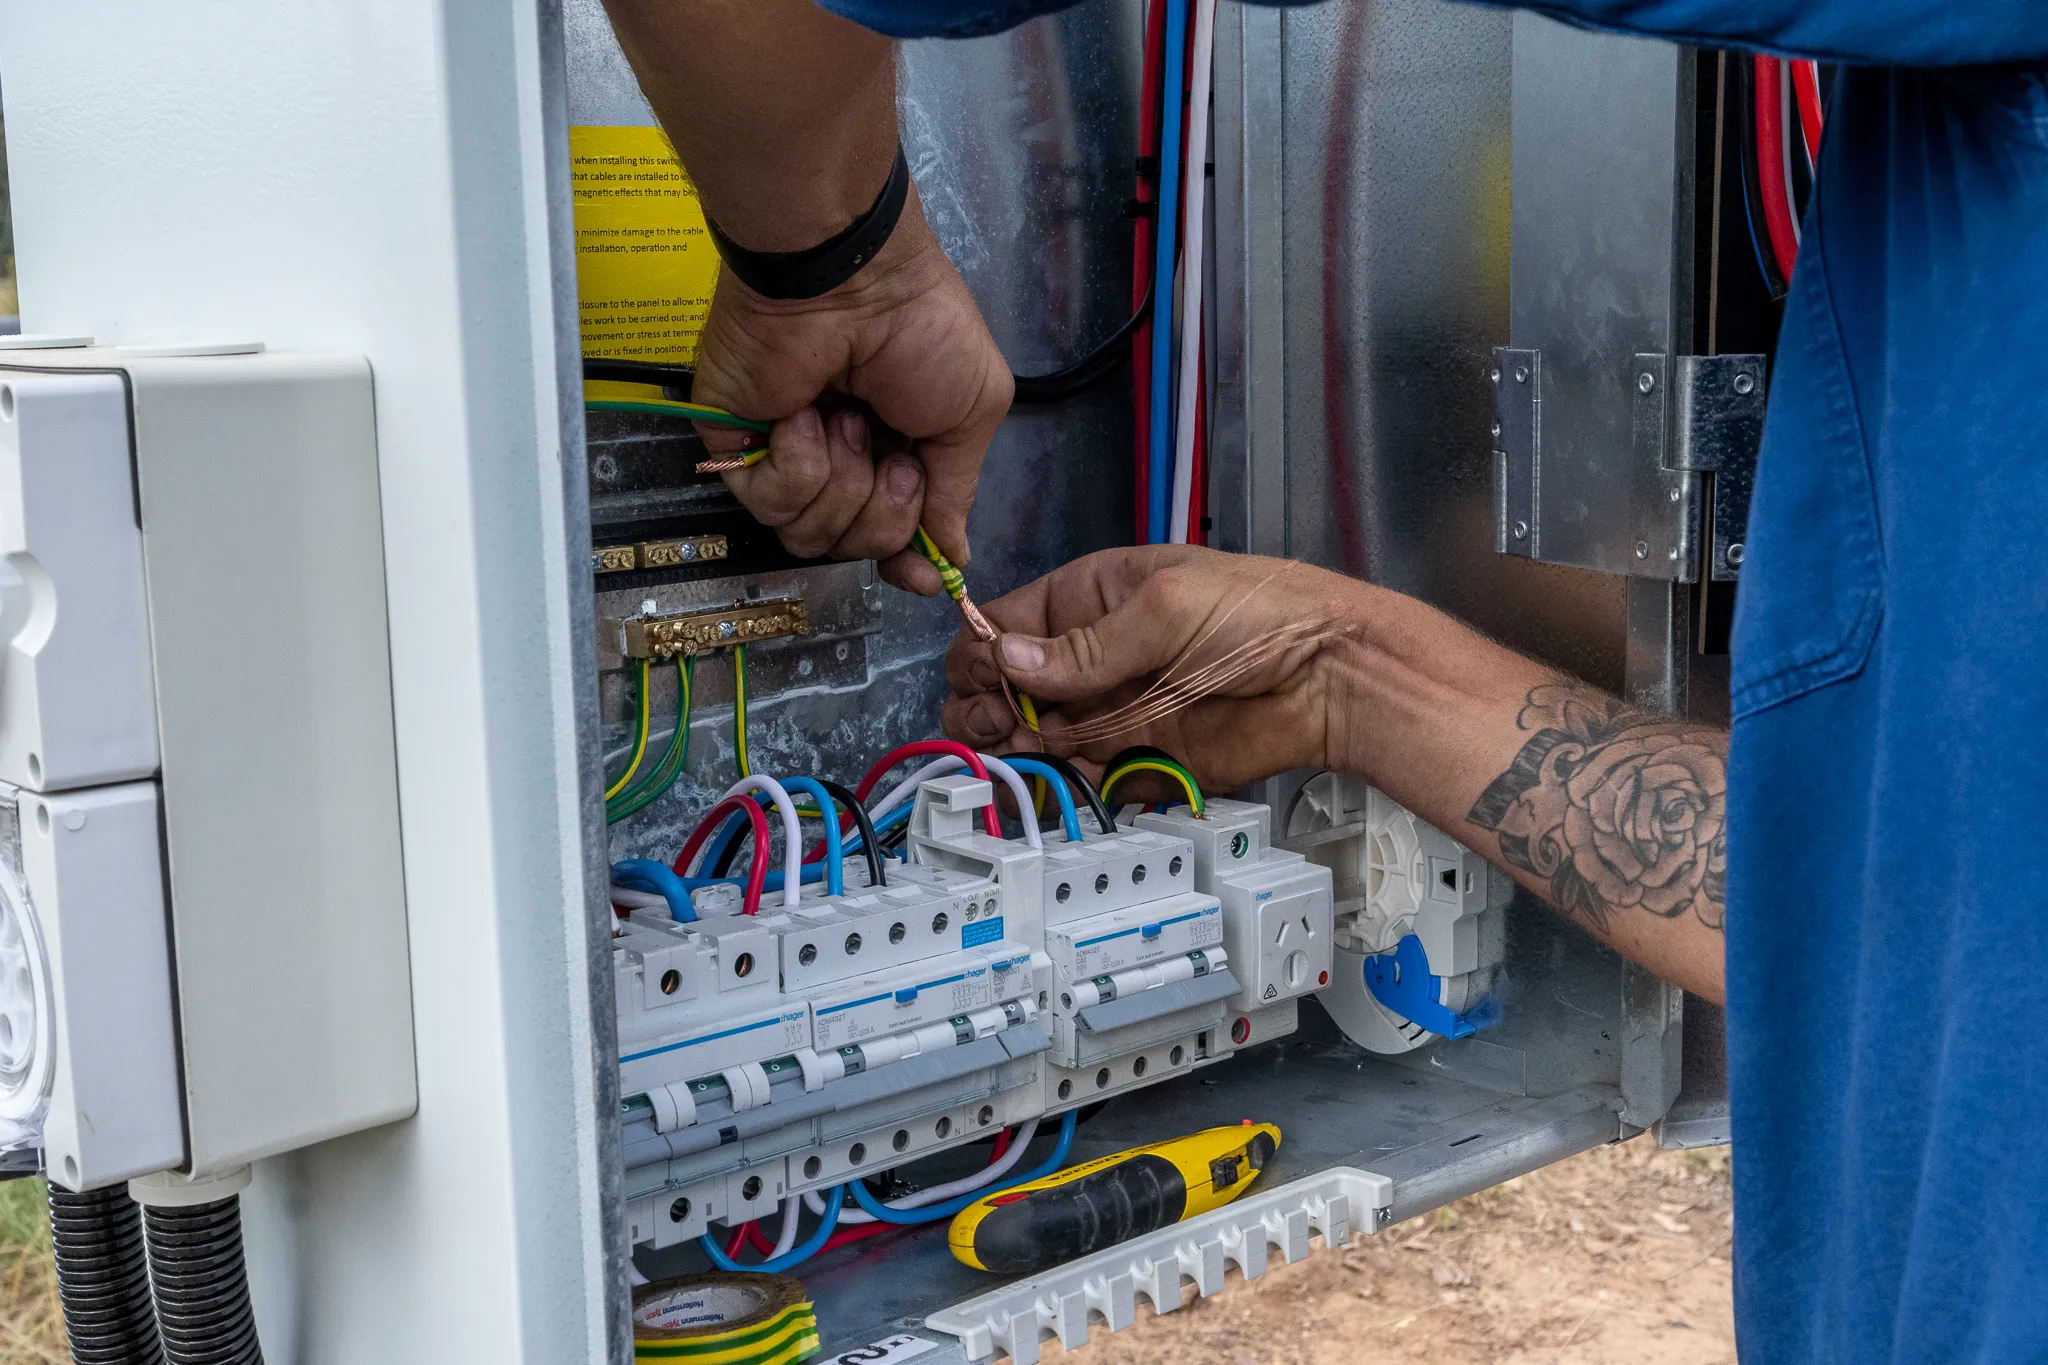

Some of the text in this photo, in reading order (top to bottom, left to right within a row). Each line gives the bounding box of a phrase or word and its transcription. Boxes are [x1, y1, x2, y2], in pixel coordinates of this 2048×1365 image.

[574, 156, 598, 165] when
[600, 156, 638, 167] installing
[639, 156, 655, 165] this
[590, 172, 617, 181] cables
[618, 173, 632, 181] are
[634, 172, 669, 181] installed
[670, 172, 680, 181] to
[573, 187, 613, 199] magnetic
[615, 187, 643, 197] effects
[644, 187, 662, 197] that
[663, 188, 681, 199] may
[581, 228, 620, 237] minimize
[621, 227, 654, 238] damage
[656, 228, 666, 236] to
[667, 227, 681, 236] the
[682, 226, 704, 236] cable
[580, 243, 629, 255] installation,
[630, 243, 670, 254] operation
[672, 242, 688, 252] and
[610, 300, 619, 309] to
[621, 299, 635, 308] the
[637, 298, 660, 309] panel
[661, 298, 671, 307] to
[672, 297, 694, 306] allow
[696, 296, 710, 306] the
[594, 315, 615, 325] work
[617, 315, 627, 324] to
[628, 314, 639, 324] be
[640, 313, 669, 323] carried
[670, 314, 688, 323] out;
[689, 311, 704, 321] and
[581, 331, 624, 341] movement
[626, 331, 635, 339] or
[636, 330, 661, 339] stress
[662, 329, 671, 338] at
[603, 348, 612, 356] or
[614, 346, 621, 355] is
[622, 346, 643, 355] fixed
[644, 345, 653, 354] in
[654, 344, 690, 355] position;
[967, 893, 980, 902] OUT
[817, 1013, 846, 1027] ADM432T
[817, 1025, 830, 1034] C32
